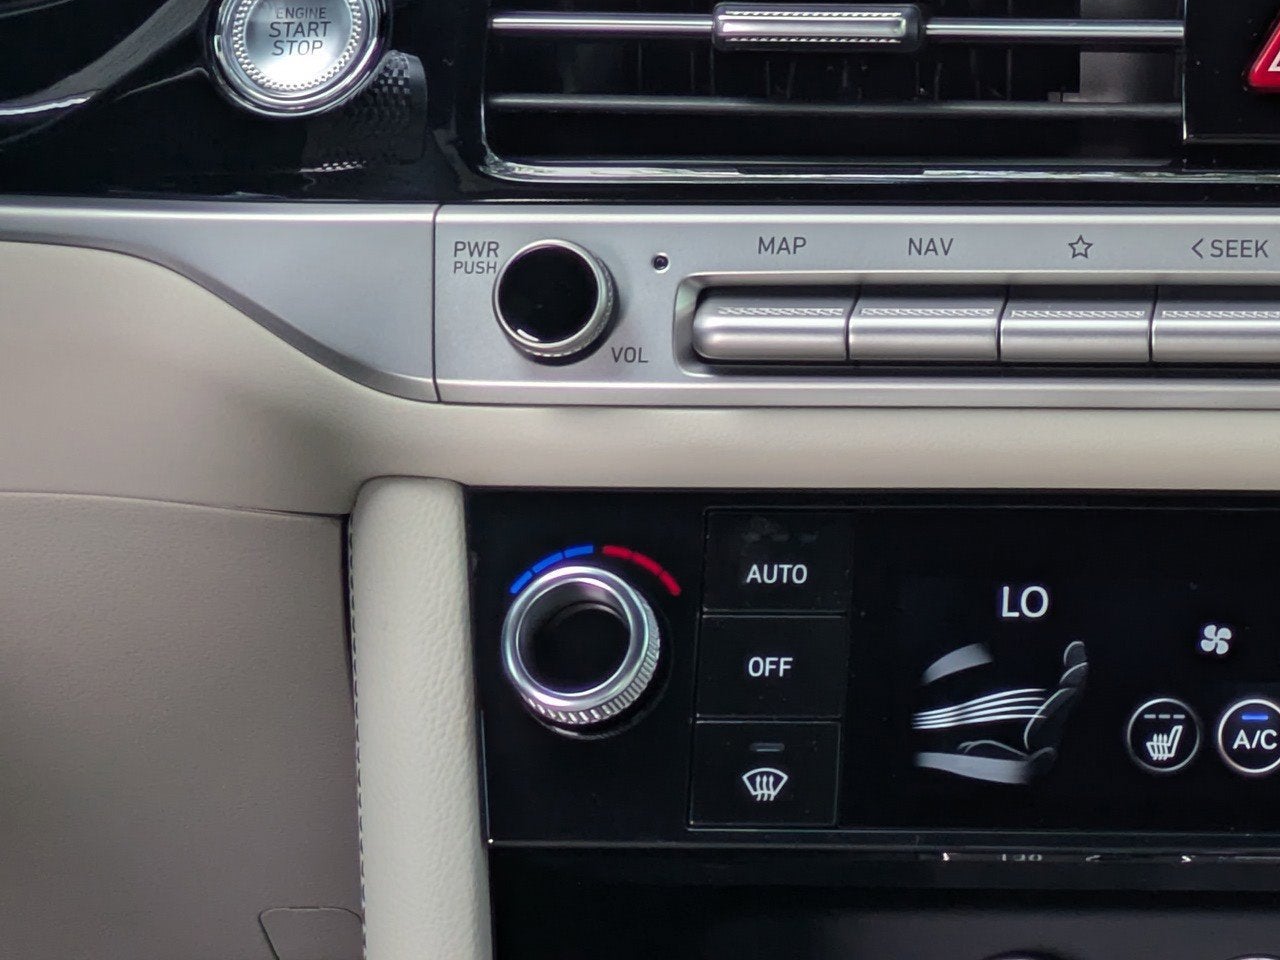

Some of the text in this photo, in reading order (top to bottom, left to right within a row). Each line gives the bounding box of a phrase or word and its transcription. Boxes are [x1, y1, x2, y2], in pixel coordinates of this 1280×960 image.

[276, 7, 327, 20] ENGINE
[269, 21, 331, 38] START
[272, 40, 323, 56] STOP
[453, 240, 499, 258] PWR
[757, 236, 807, 255] MAP
[907, 237, 954, 256] NAV
[453, 260, 497, 275] PUSH
[610, 346, 649, 364] VOL
[745, 563, 808, 584] AUTO
[1001, 585, 1049, 618] LO
[748, 656, 794, 677] OFF
[1232, 729, 1278, 751] A/C
